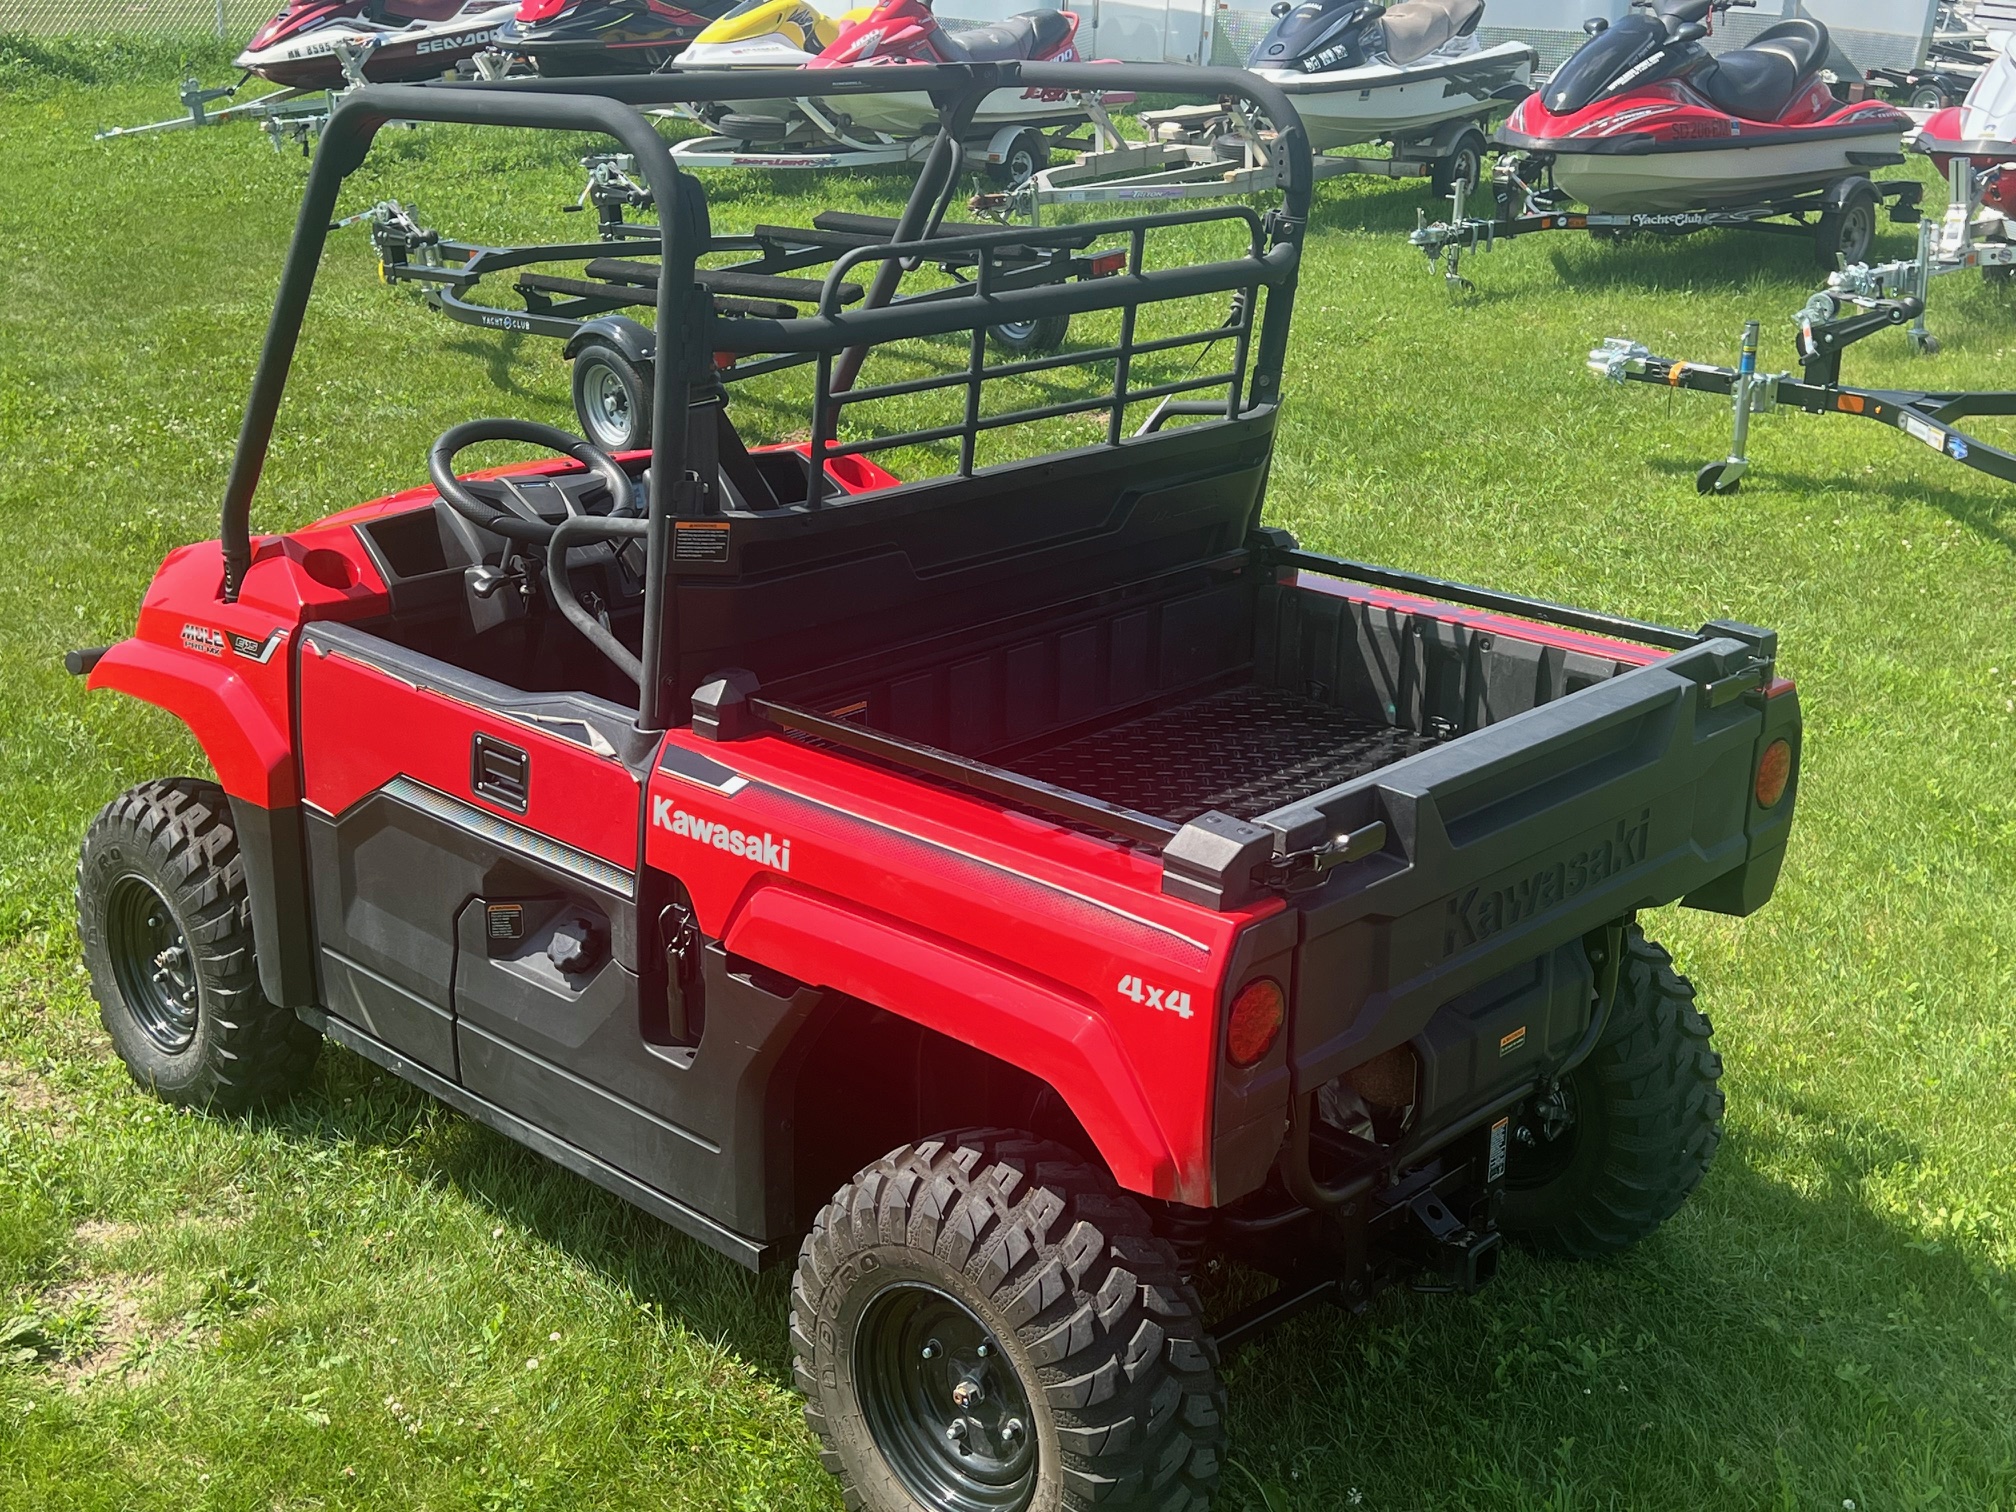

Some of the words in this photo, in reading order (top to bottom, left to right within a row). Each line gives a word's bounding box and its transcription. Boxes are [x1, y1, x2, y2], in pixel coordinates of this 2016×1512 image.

[287, 48, 301, 59] MN
[307, 42, 331, 56] 8595
[1672, 122, 1689, 140] SD
[1132, 190, 1163, 199] TRITON
[1632, 213, 1669, 227] Yacht
[1669, 213, 1702, 226] Club
[482, 315, 503, 327] YACHT
[512, 320, 530, 330] CLUB
[181, 624, 224, 649] MULE
[235, 637, 258, 653] EPS
[653, 795, 791, 873] Kawasaki
[1443, 808, 1650, 958] Kawasaki
[1117, 974, 1194, 1019] 4x4
